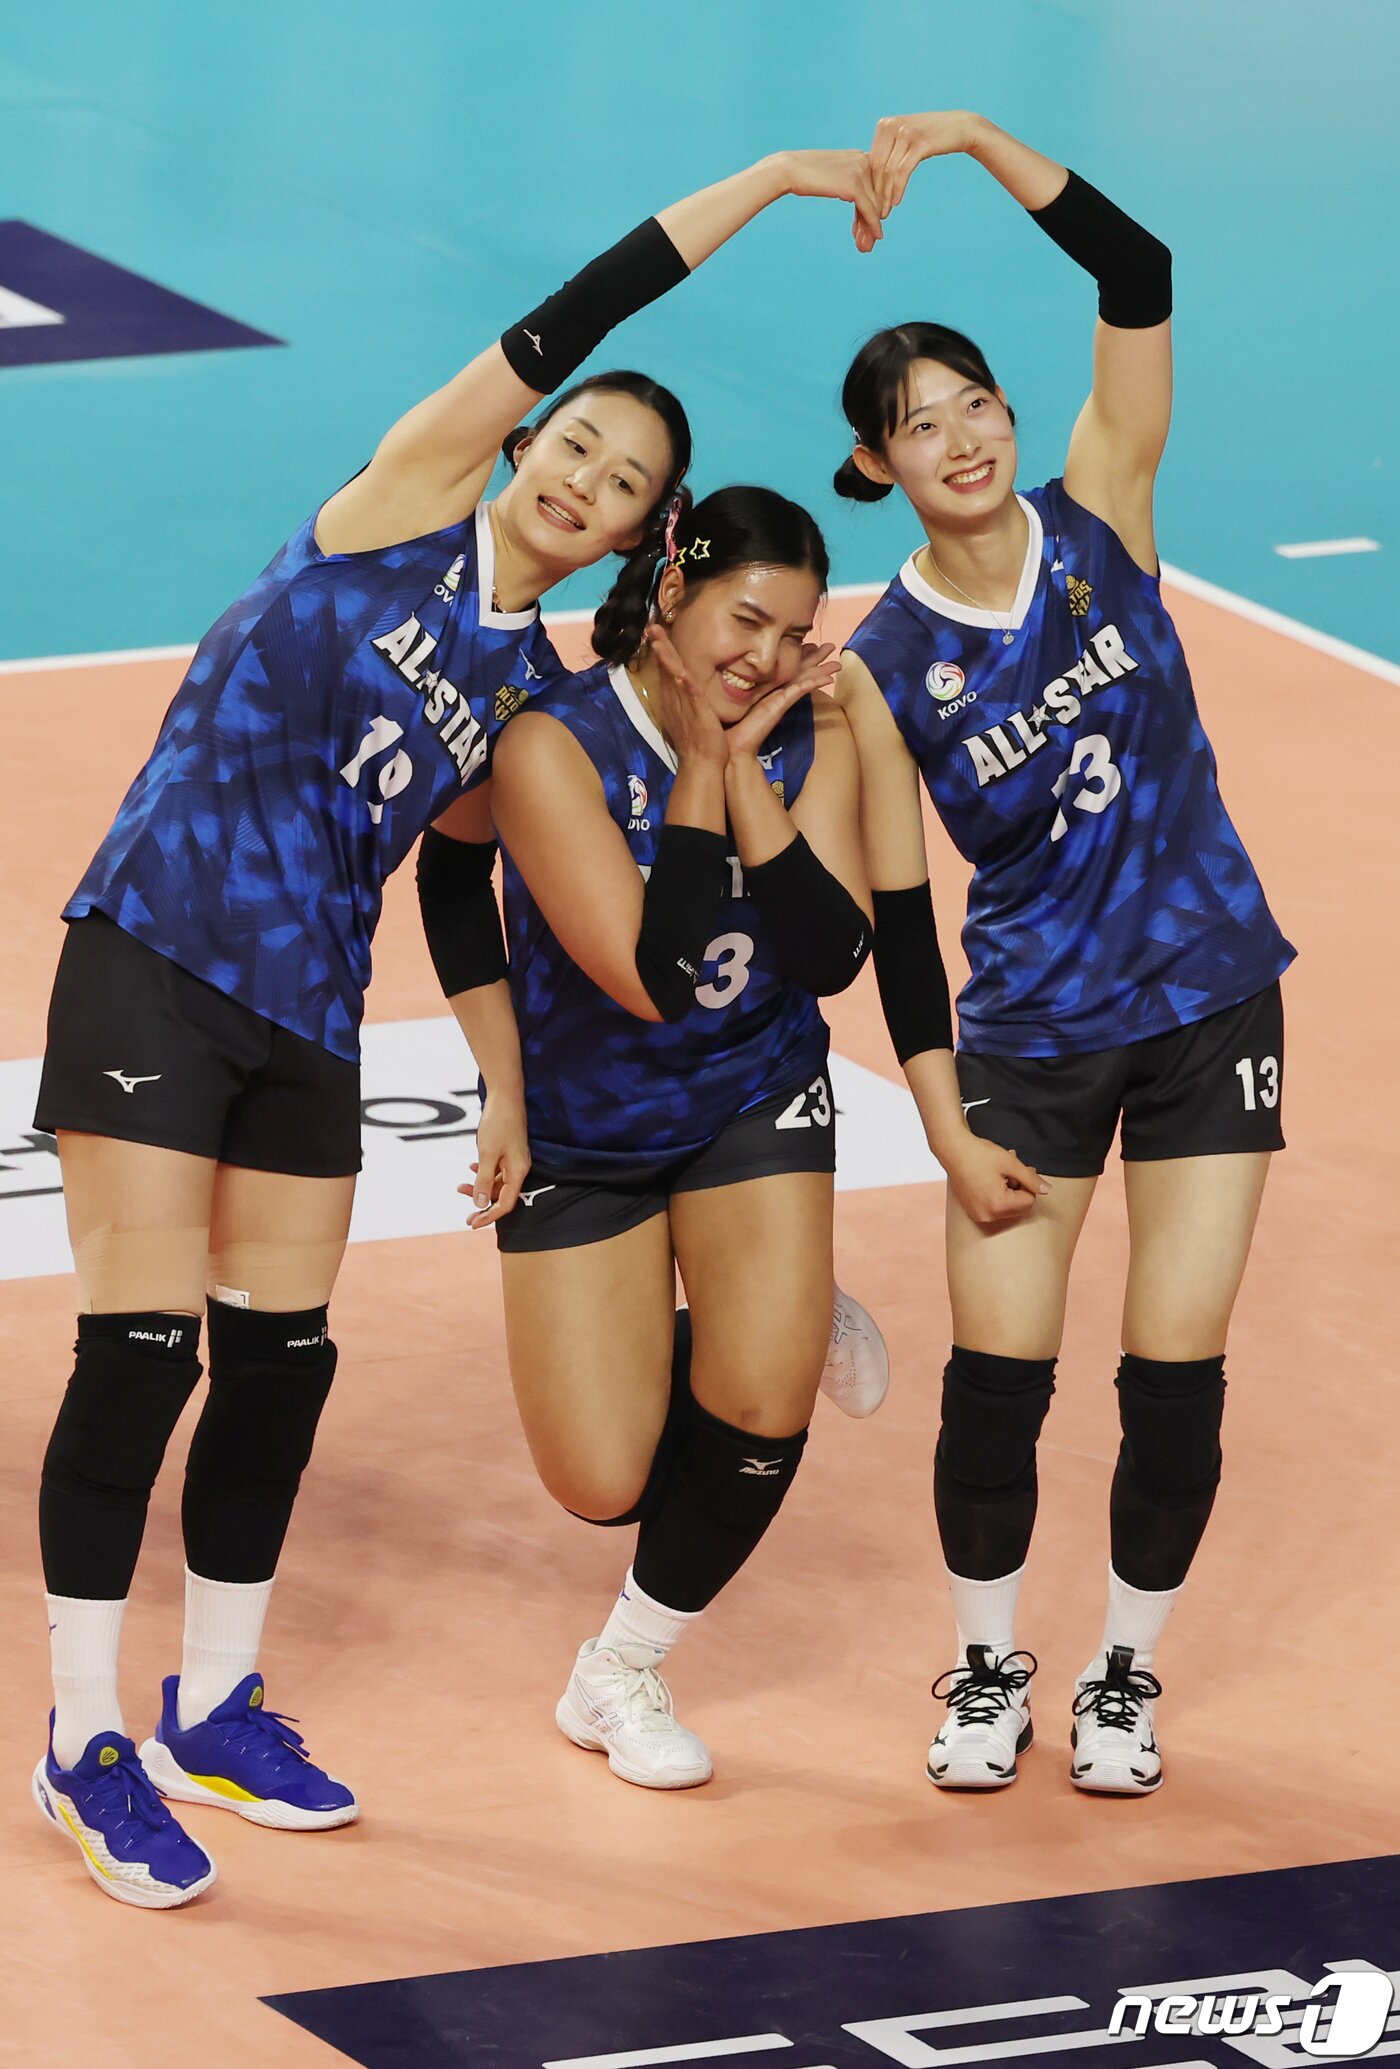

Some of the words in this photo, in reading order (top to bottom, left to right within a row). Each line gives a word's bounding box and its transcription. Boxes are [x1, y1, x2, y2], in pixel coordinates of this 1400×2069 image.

[937, 691, 977, 720] KOVO
[1236, 1056, 1279, 1110] 13
[775, 1076, 831, 1130] 23
[128, 1331, 167, 1343] PAALIK
[287, 1335, 320, 1348] PAALIK
